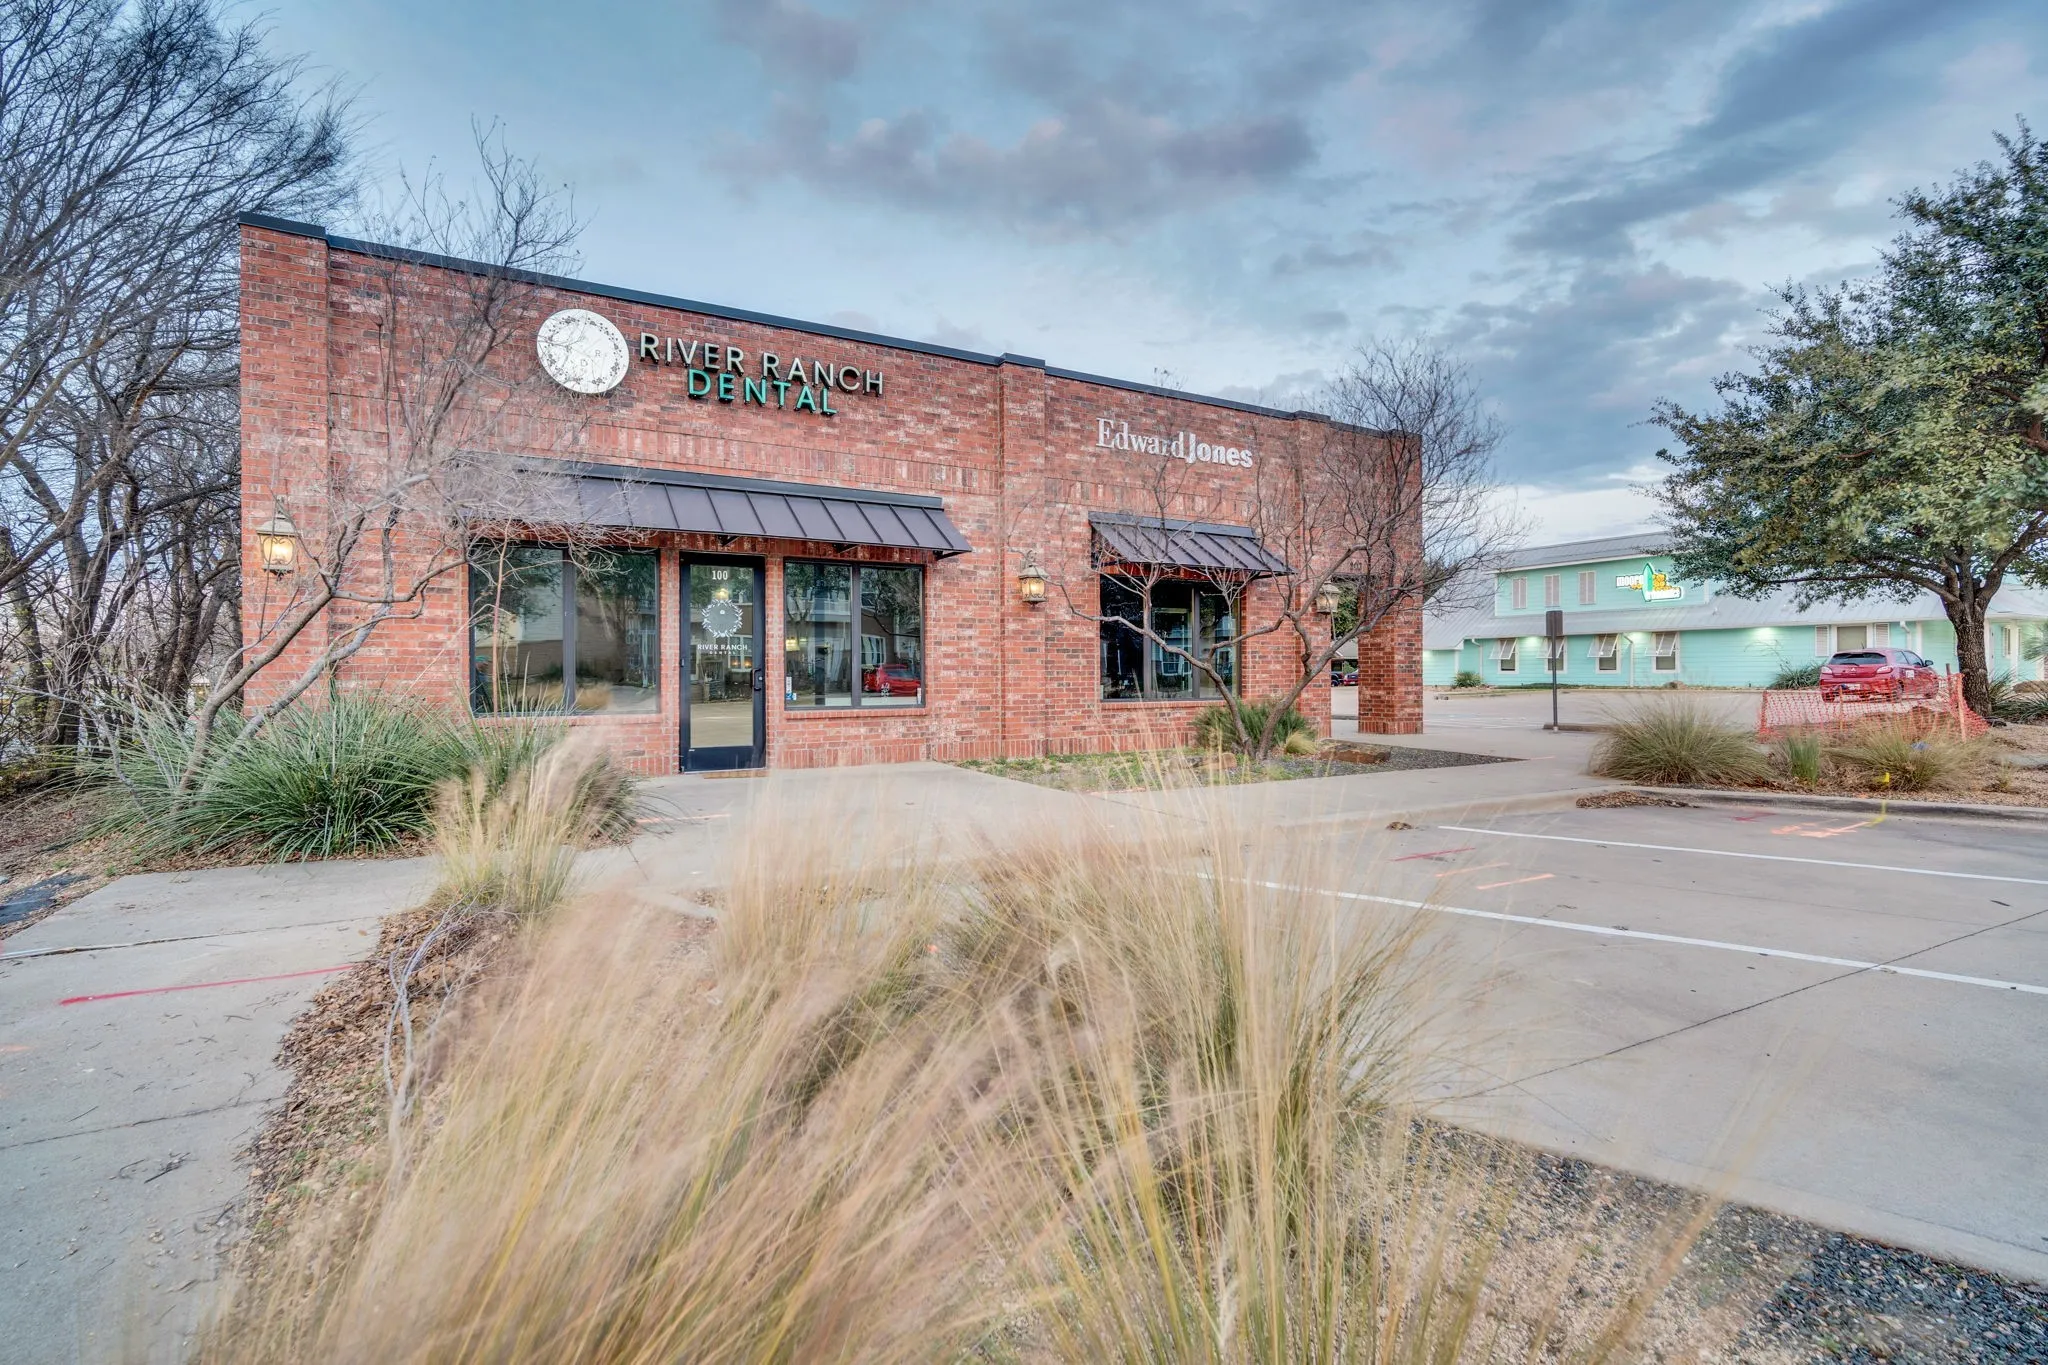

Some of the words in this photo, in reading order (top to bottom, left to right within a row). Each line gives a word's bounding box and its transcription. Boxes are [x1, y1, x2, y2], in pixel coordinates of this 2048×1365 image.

[640, 332, 744, 376] RIVER
[762, 352, 883, 395] RANCH
[688, 369, 838, 414] DENTAL
[711, 570, 728, 581] 100
